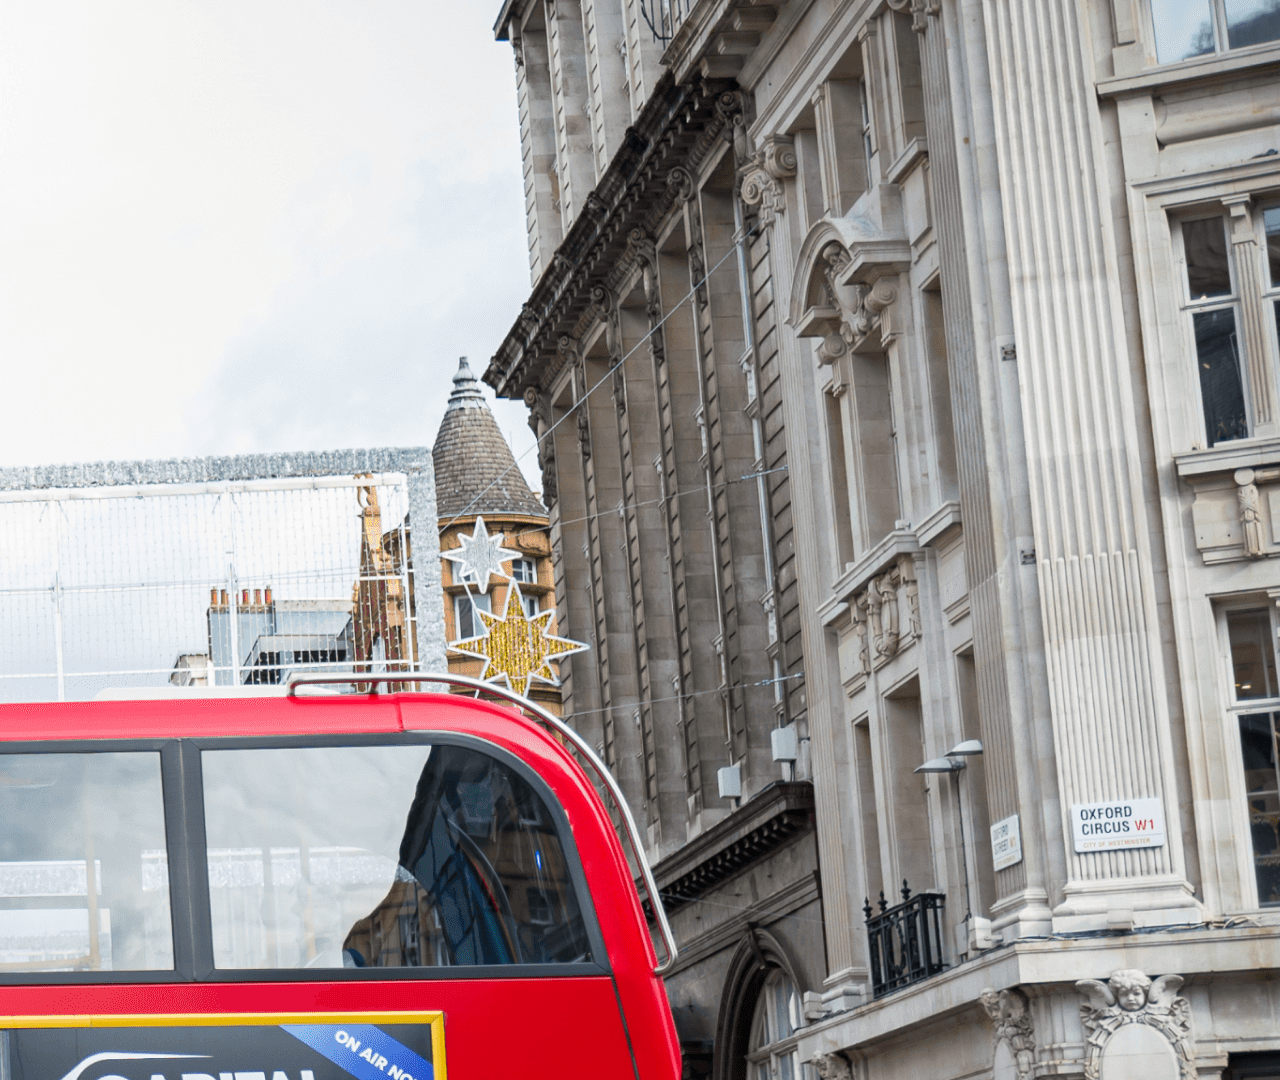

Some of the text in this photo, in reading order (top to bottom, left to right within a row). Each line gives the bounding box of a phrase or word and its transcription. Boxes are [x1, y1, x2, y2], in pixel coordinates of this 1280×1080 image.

[1080, 805, 1133, 822] OXFORD
[1081, 818, 1154, 836] CIRCUS W1
[1108, 837, 1151, 848] WESTMINSTER
[334, 1029, 360, 1055] ON
[359, 1047, 387, 1074] AIR
